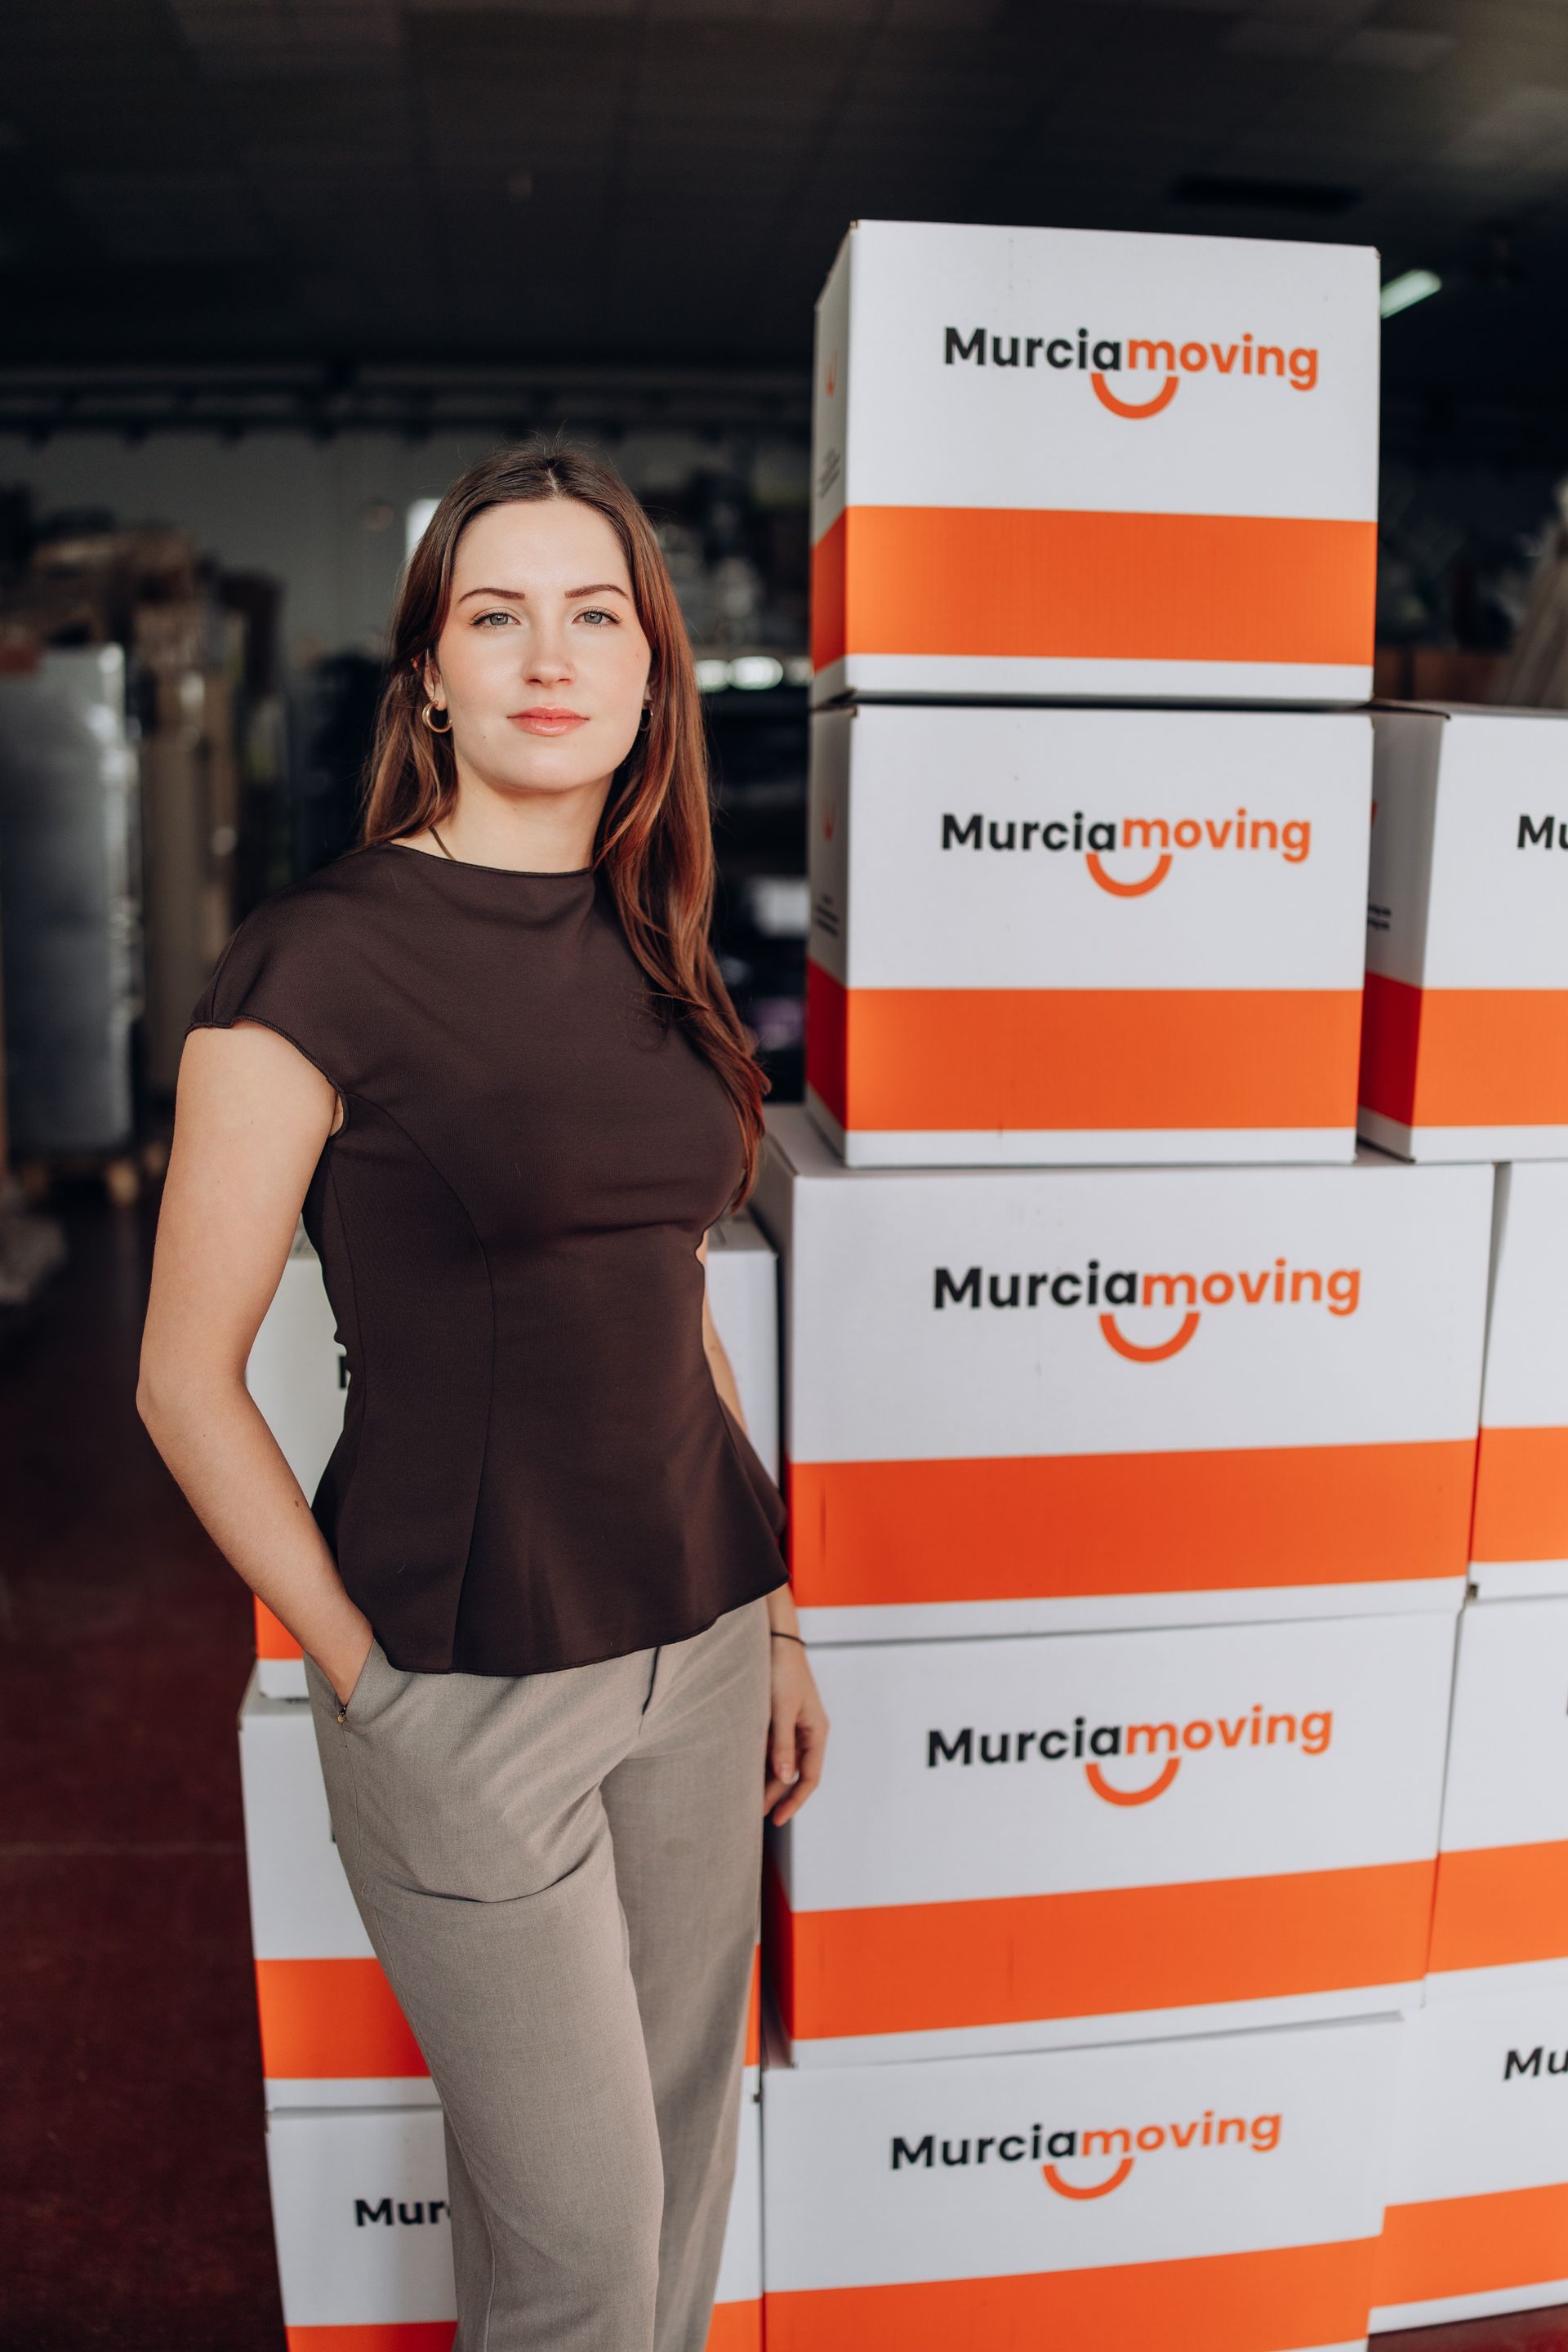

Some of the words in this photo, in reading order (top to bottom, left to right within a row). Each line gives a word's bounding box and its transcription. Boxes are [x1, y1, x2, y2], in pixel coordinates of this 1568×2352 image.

[944, 327, 1318, 392] Murciamoving
[941, 808, 1311, 864] Murciamoving
[933, 1258, 1361, 1317] Murciamoving
[927, 1704, 1333, 1769] Murciamoving
[891, 2110, 1281, 2171] Murciamoving
[354, 2197, 451, 2227] Mur
